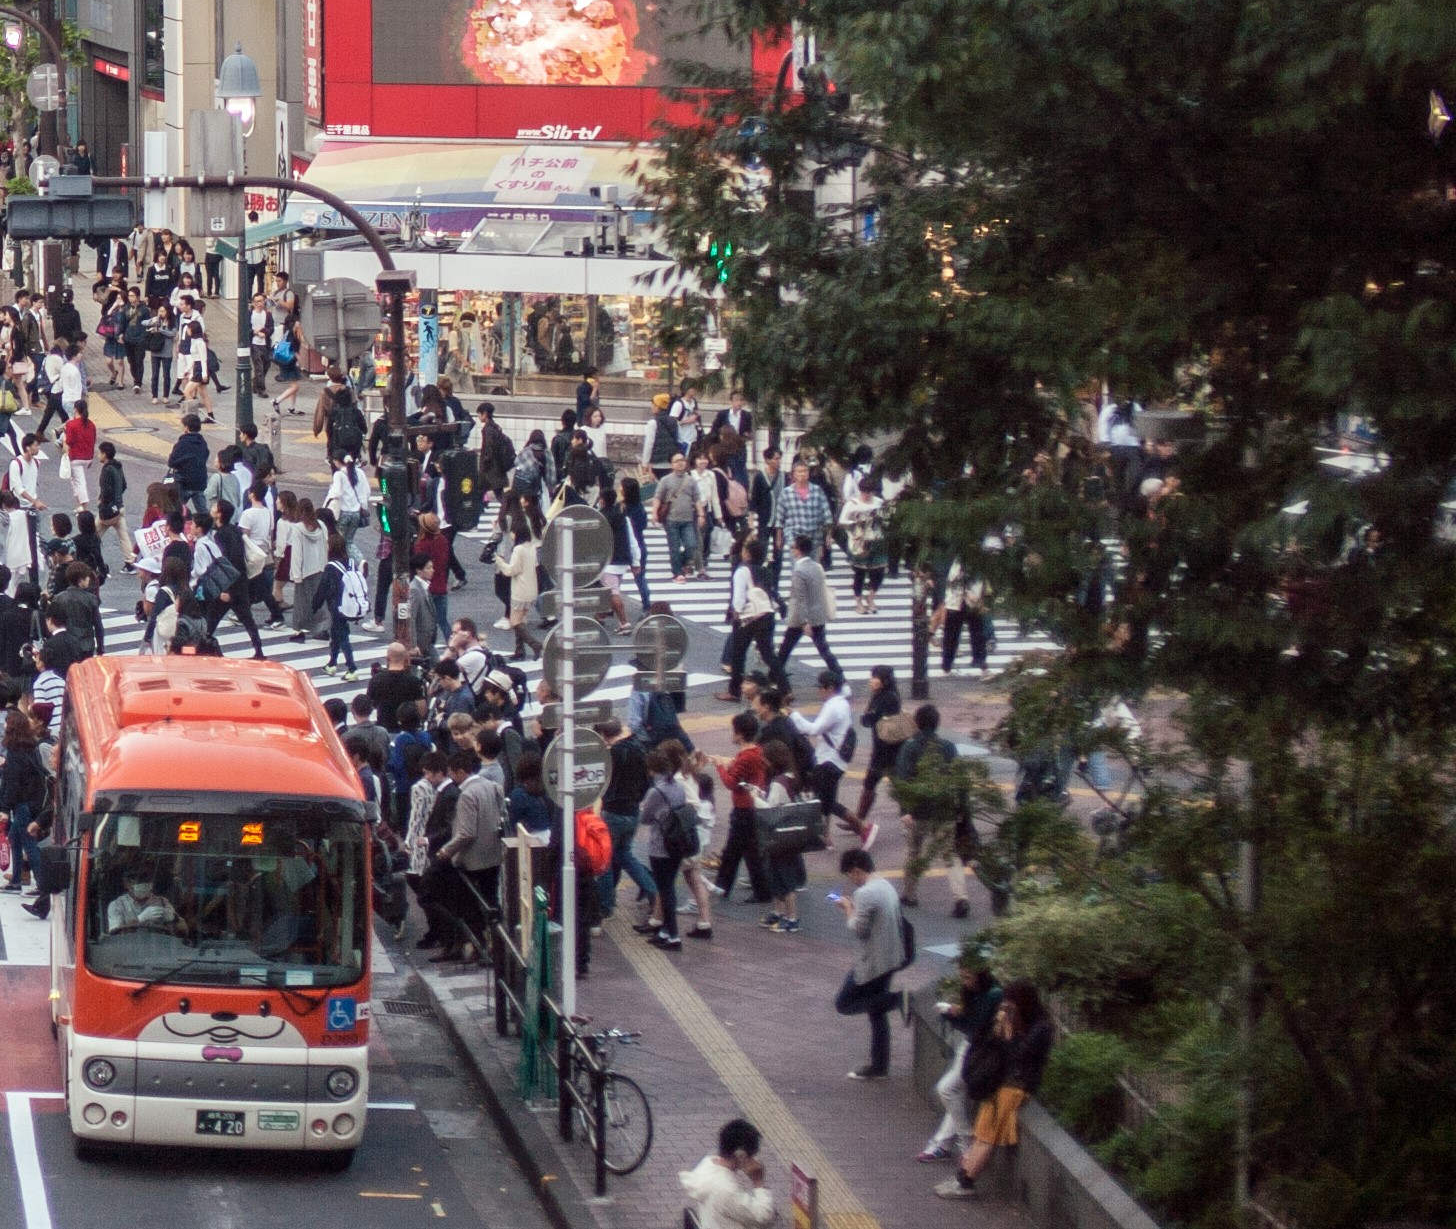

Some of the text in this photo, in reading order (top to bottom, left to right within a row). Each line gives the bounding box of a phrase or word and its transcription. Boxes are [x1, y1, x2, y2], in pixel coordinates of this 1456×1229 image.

[509, 157, 580, 170] ハチ公前
[529, 170, 545, 179] の
[493, 179, 574, 192] くすり屋さん
